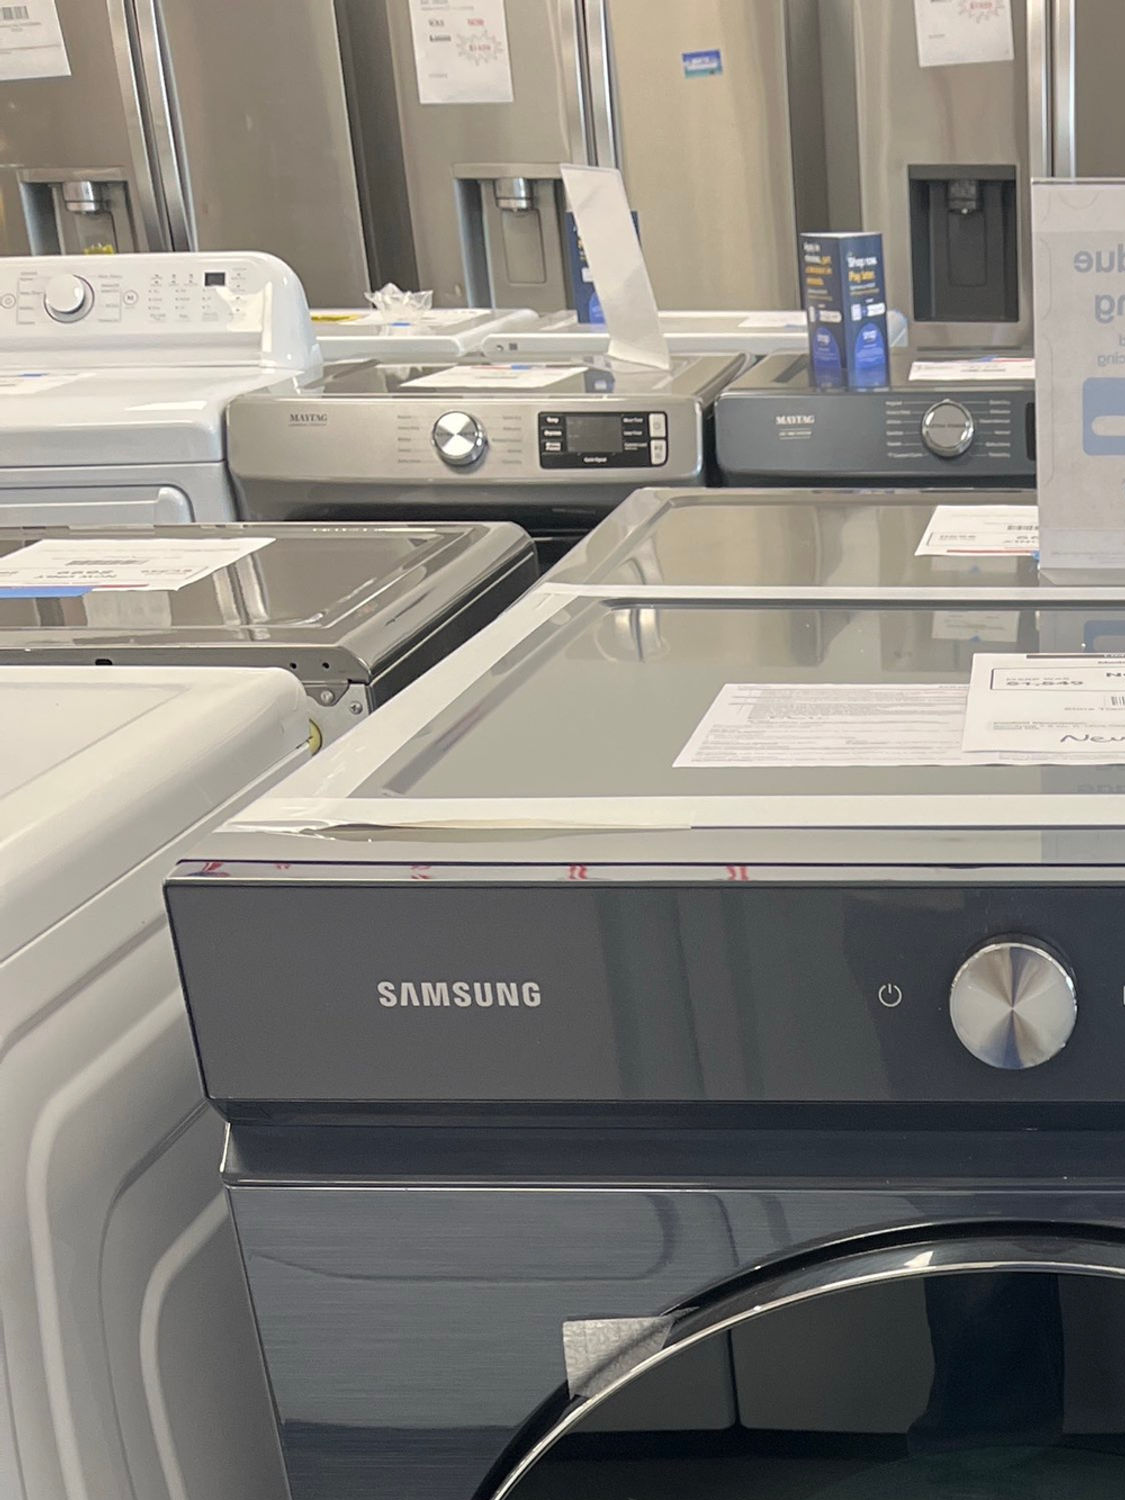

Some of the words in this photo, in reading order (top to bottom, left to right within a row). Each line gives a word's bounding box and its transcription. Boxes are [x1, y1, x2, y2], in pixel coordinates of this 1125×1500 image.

[289, 413, 328, 422] MAYTAG
[775, 415, 815, 425] MAYTAG
[377, 980, 542, 1008] SAMSUNG
